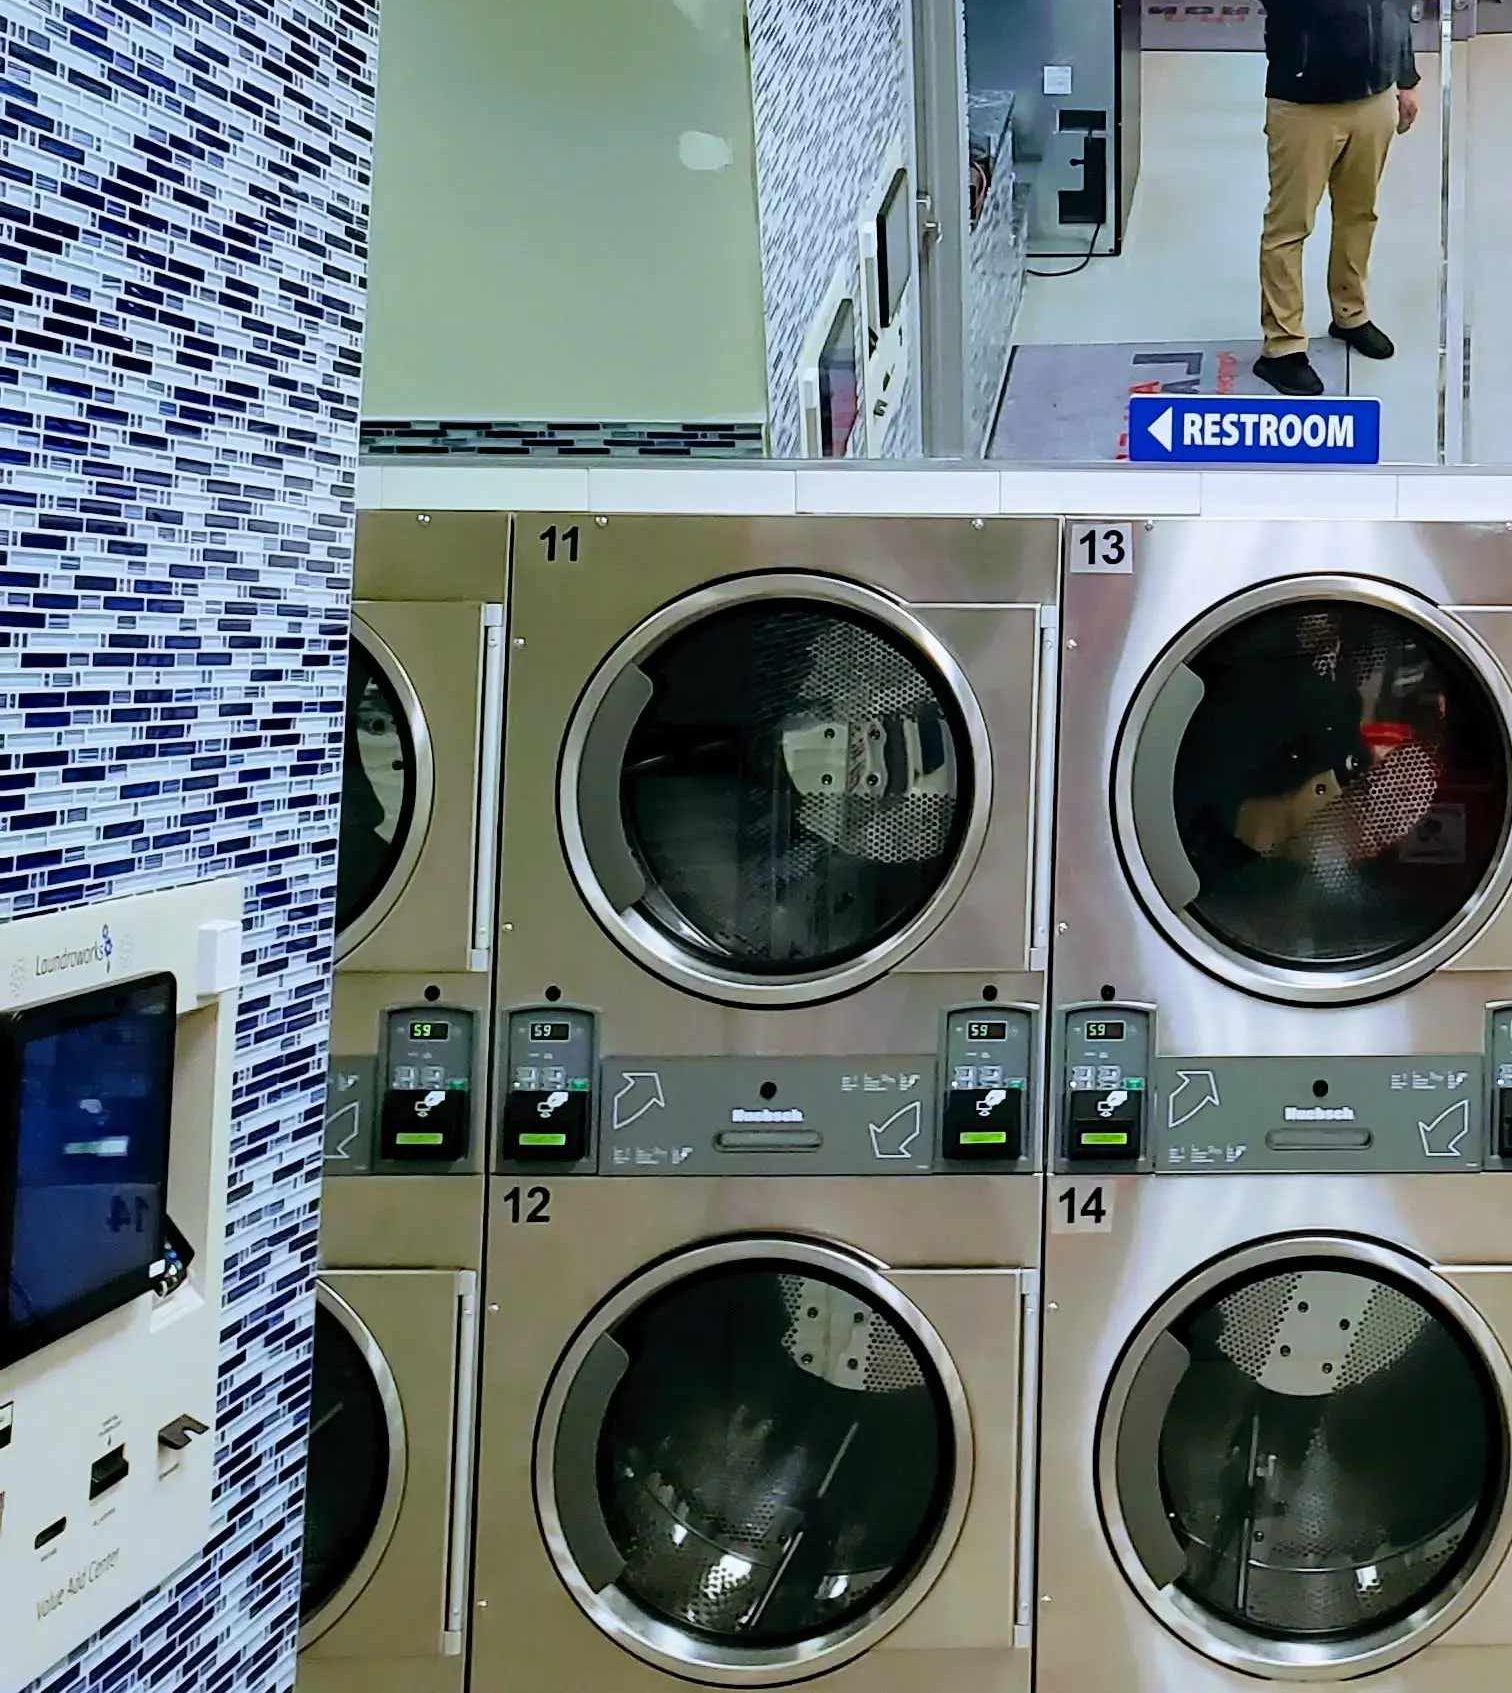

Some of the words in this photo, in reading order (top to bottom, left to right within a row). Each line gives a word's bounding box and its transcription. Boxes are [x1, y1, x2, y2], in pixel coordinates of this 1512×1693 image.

[1182, 412, 1355, 449] RESTROOM
[539, 525, 579, 562] 11
[1079, 529, 1125, 565] 13
[503, 1186, 551, 1224] 12
[1059, 1186, 1106, 1224] 14
